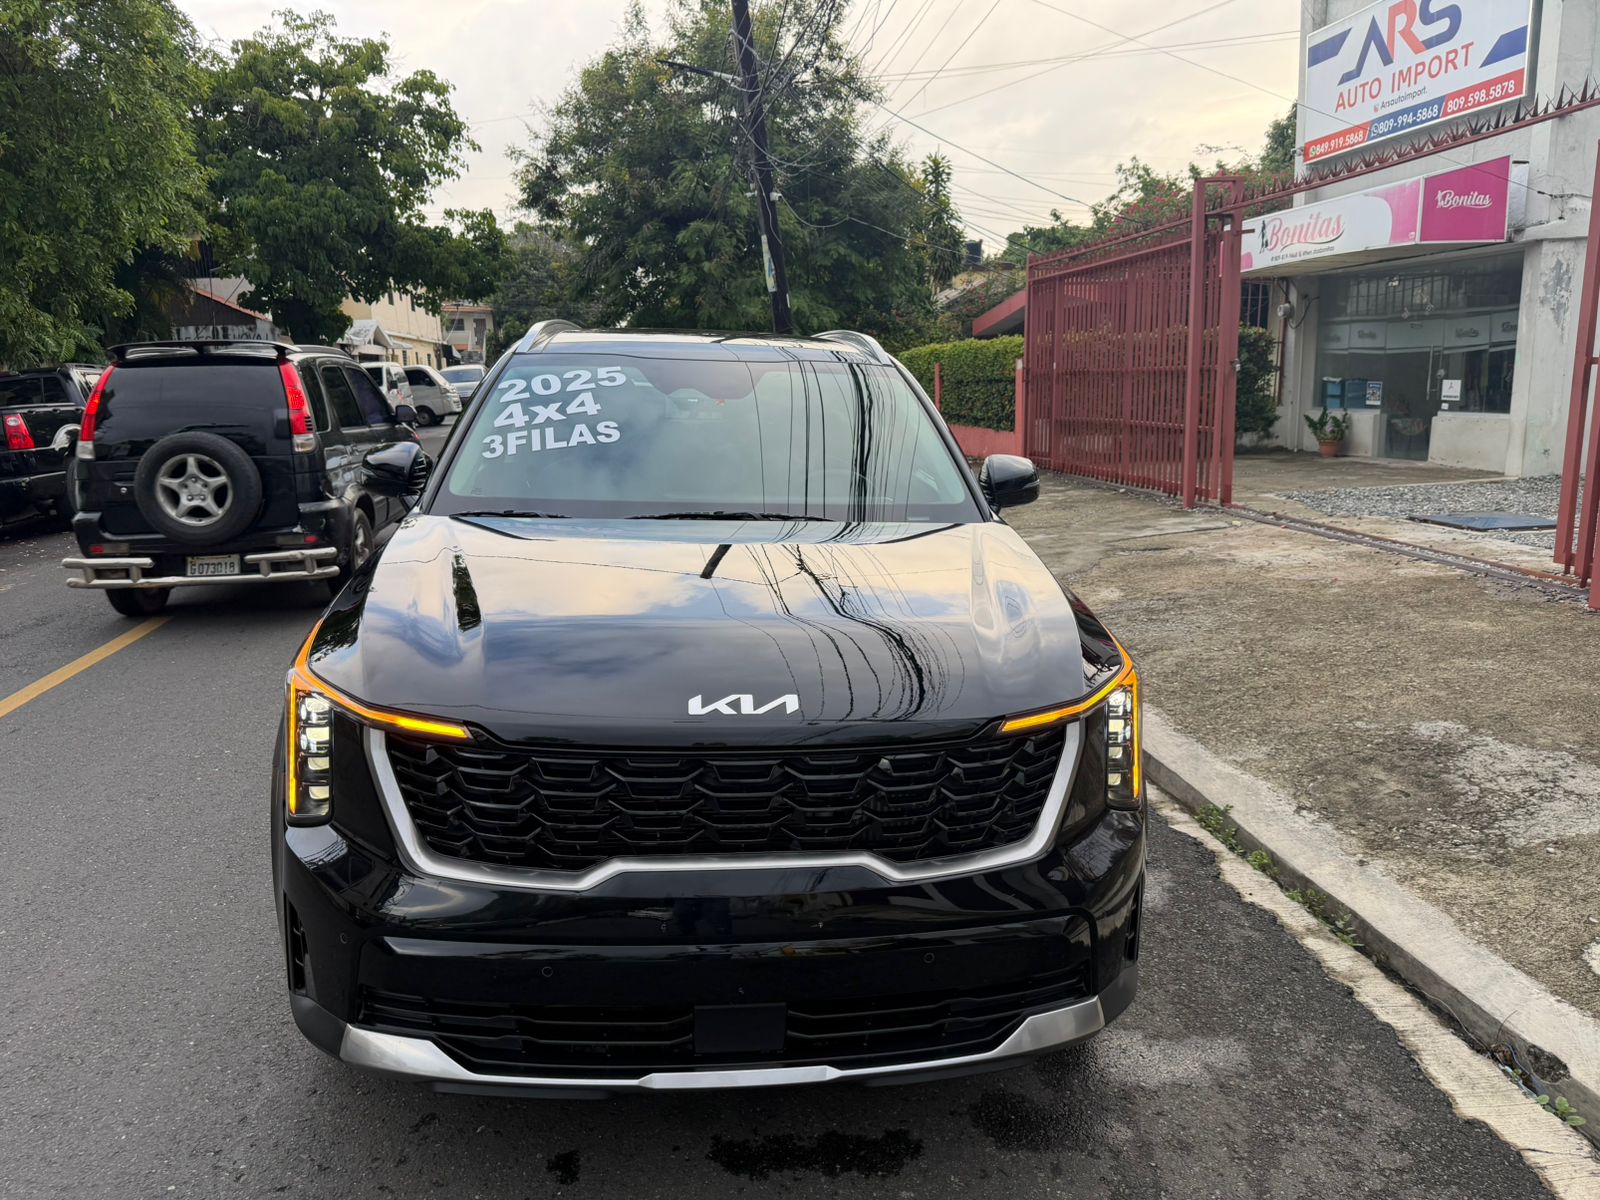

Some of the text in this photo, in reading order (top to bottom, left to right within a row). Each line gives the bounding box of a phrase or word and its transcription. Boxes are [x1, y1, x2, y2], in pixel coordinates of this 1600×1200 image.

[1337, 0, 1462, 86] ARS
[1335, 42, 1475, 113] AUTO IMPORT
[1378, 104, 1439, 134] 809-994-5868
[1446, 79, 1515, 113] 809.598.5878
[1439, 190, 1493, 210] Bonitas
[1266, 212, 1344, 251] Bonitas
[498, 366, 627, 402] 2025
[493, 391, 601, 428] 4x4
[481, 421, 621, 459] 3FILAS
